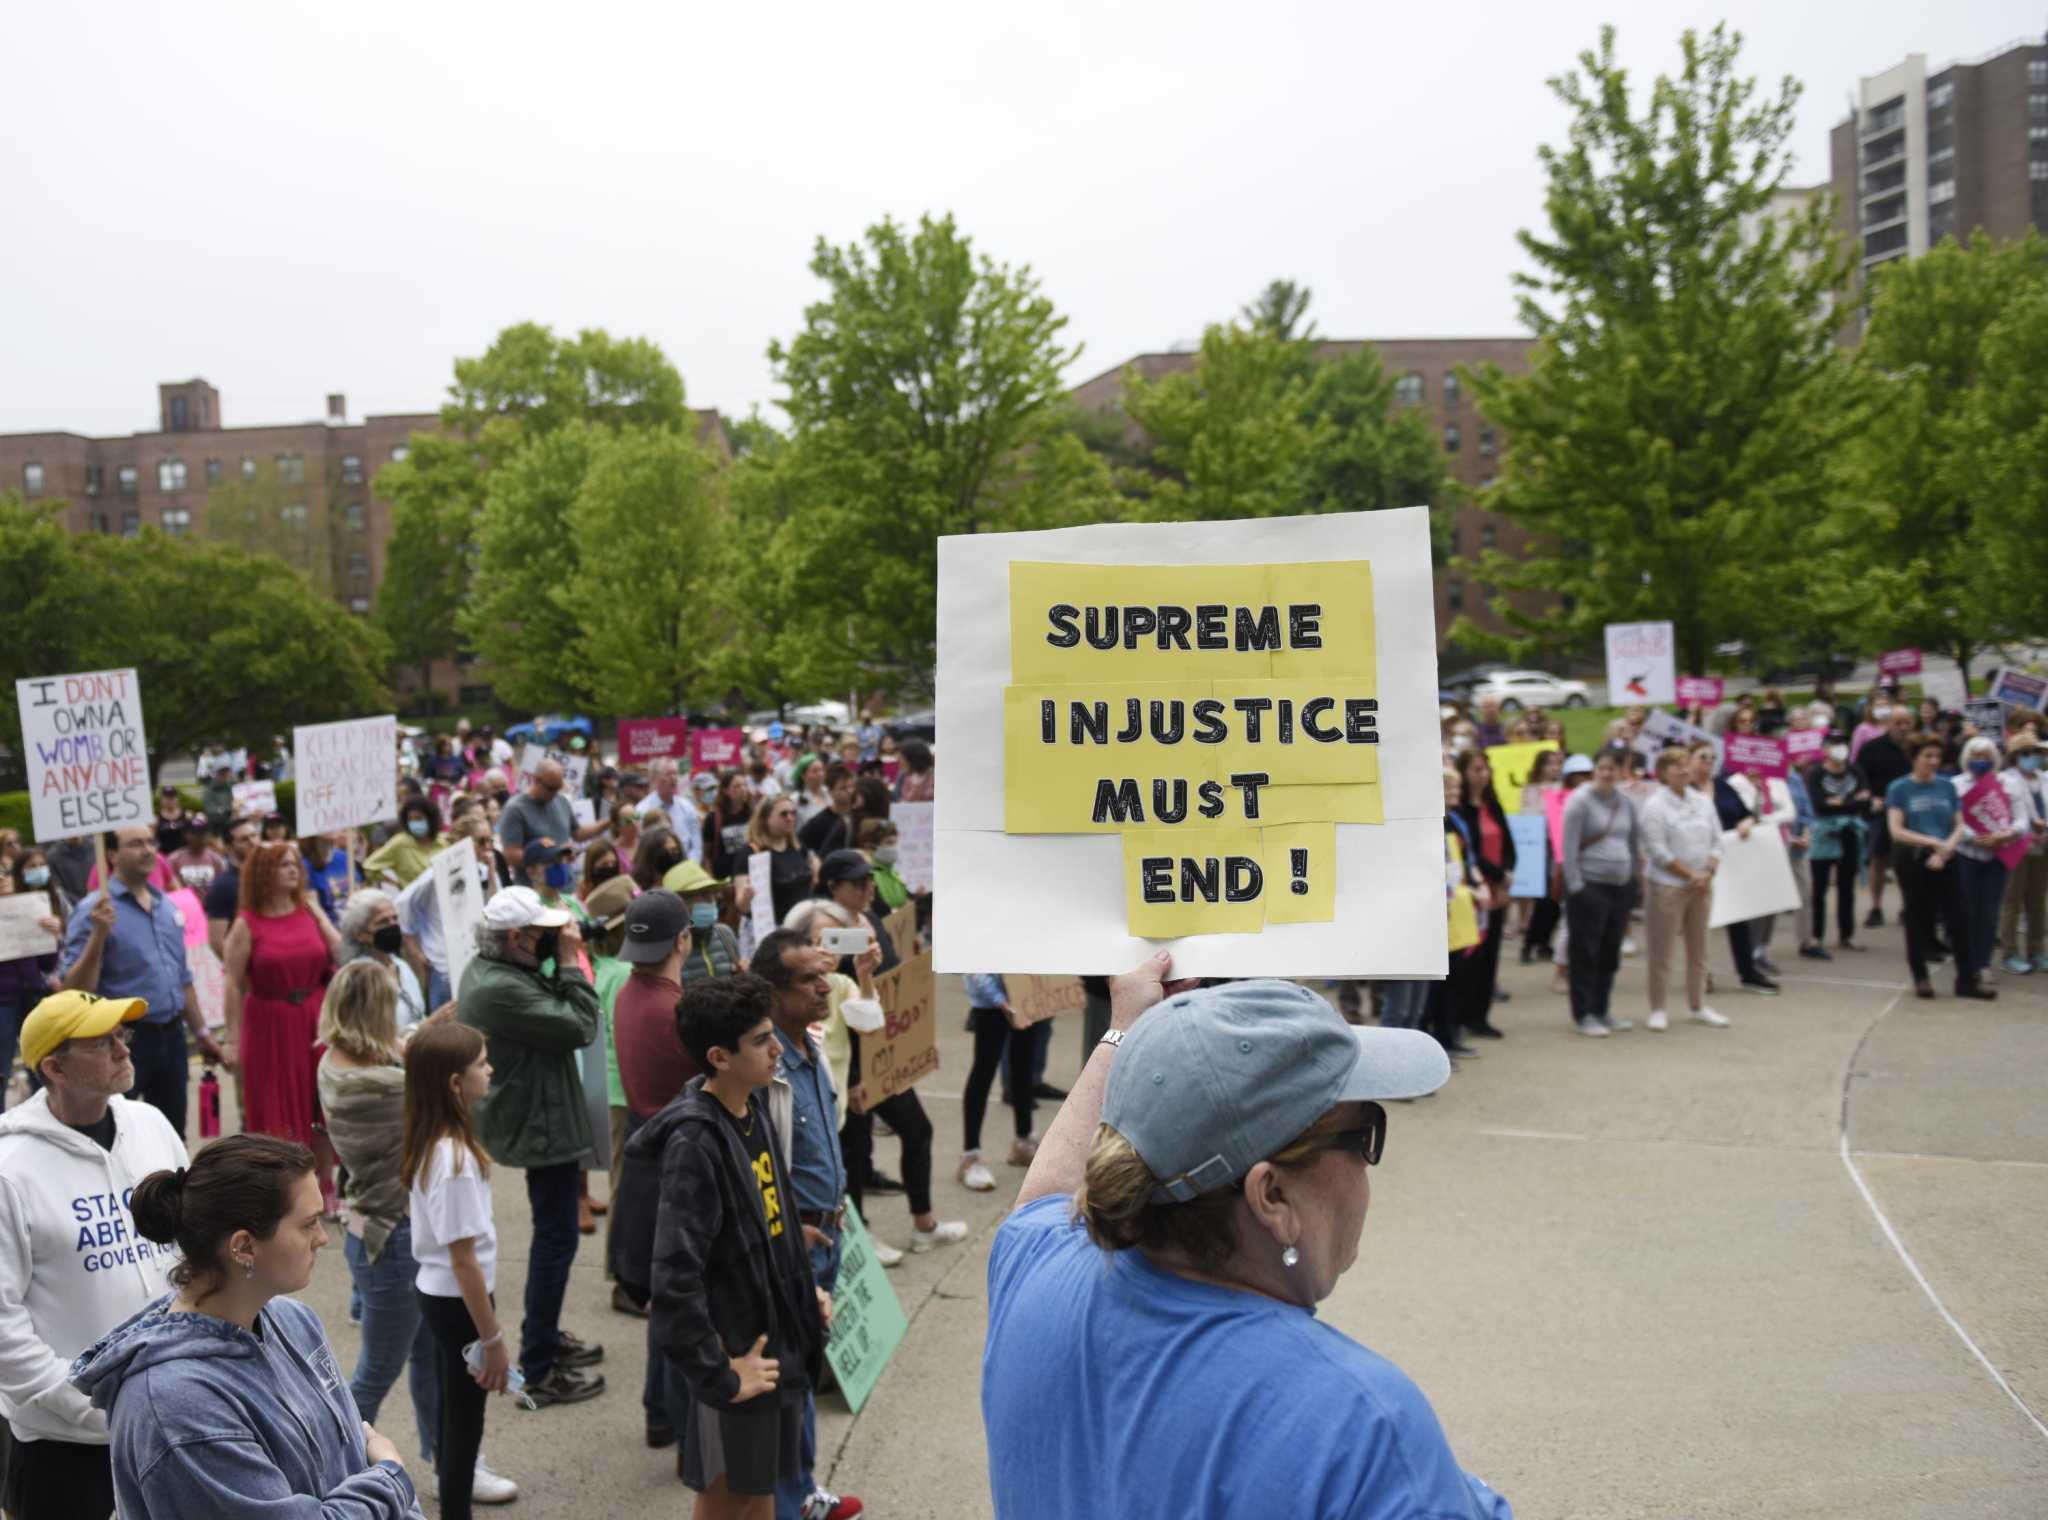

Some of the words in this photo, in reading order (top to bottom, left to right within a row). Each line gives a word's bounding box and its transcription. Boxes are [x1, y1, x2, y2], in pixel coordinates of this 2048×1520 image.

[1046, 604, 1323, 652] SUPREME
[29, 681, 58, 707] I
[1041, 697, 1380, 744] INJUSTICE
[36, 734, 104, 766] WOMB
[108, 728, 137, 758] OR
[42, 757, 145, 798] ANYONE
[303, 784, 337, 809] OFF
[60, 786, 141, 830] ELSES
[1141, 856, 1264, 904] END
[1289, 848, 1309, 896] !
